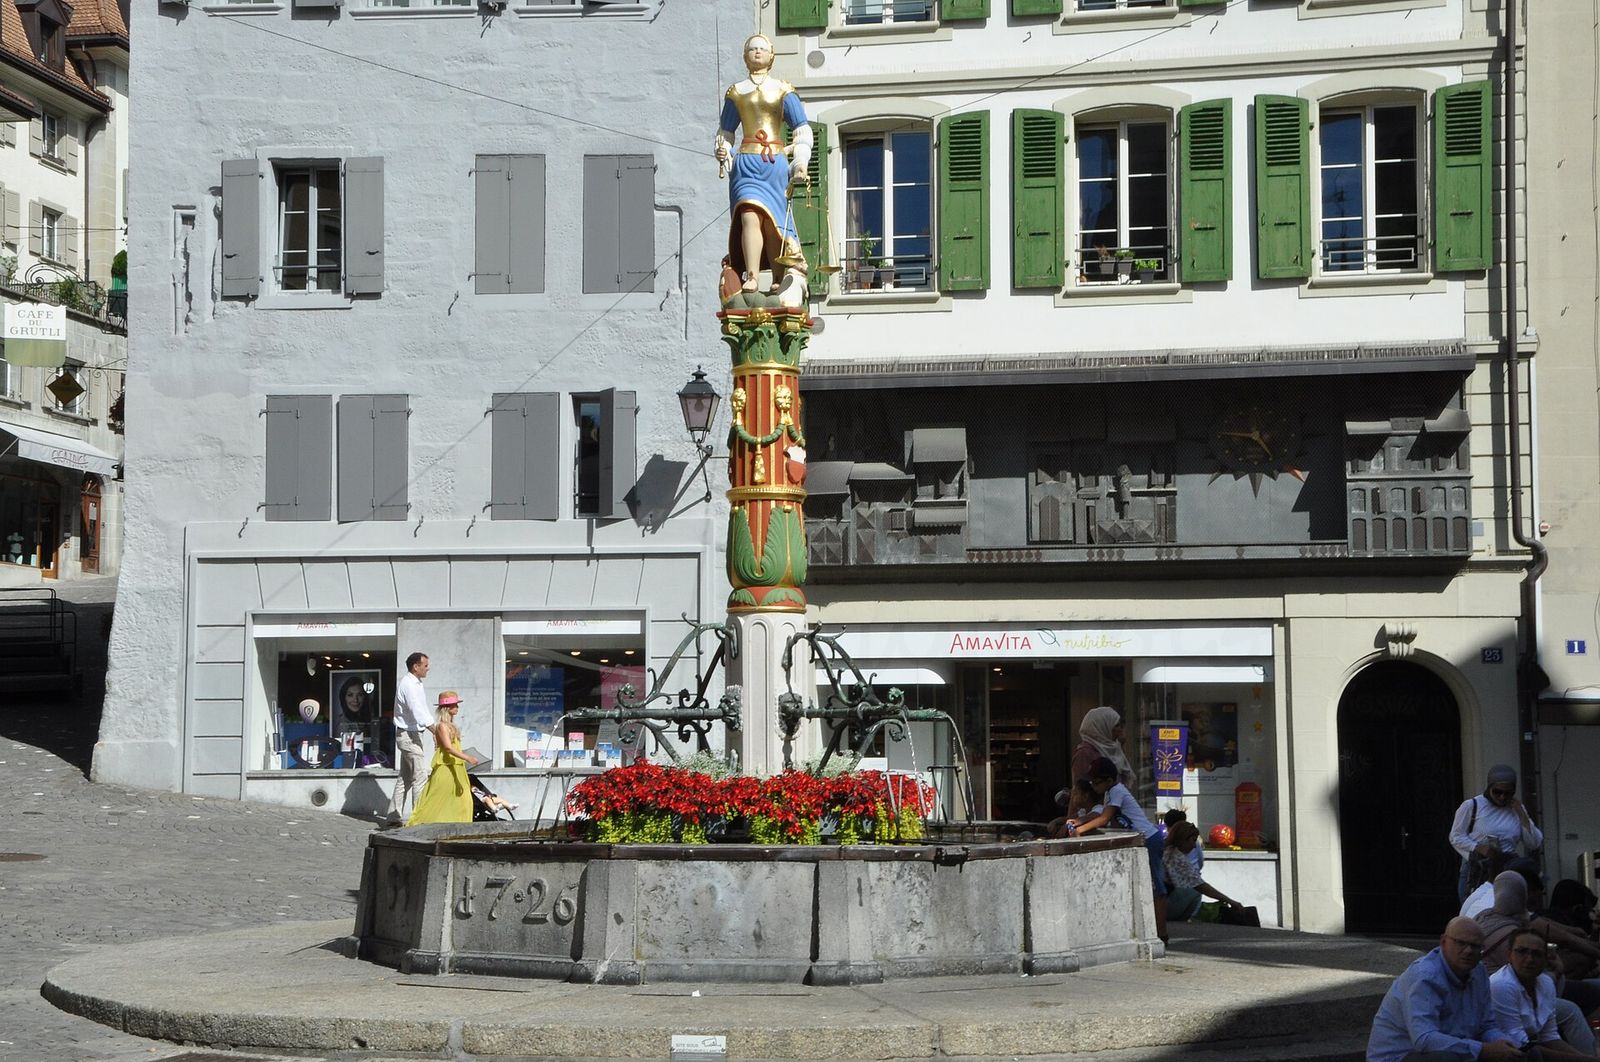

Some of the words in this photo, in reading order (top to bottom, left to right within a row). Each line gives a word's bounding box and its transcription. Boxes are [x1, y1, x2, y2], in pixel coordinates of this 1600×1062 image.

[10, 326, 60, 336] GRUTLI
[1064, 633, 1132, 650] nutribio
[1572, 641, 1580, 653] 1
[1483, 649, 1501, 662] 23
